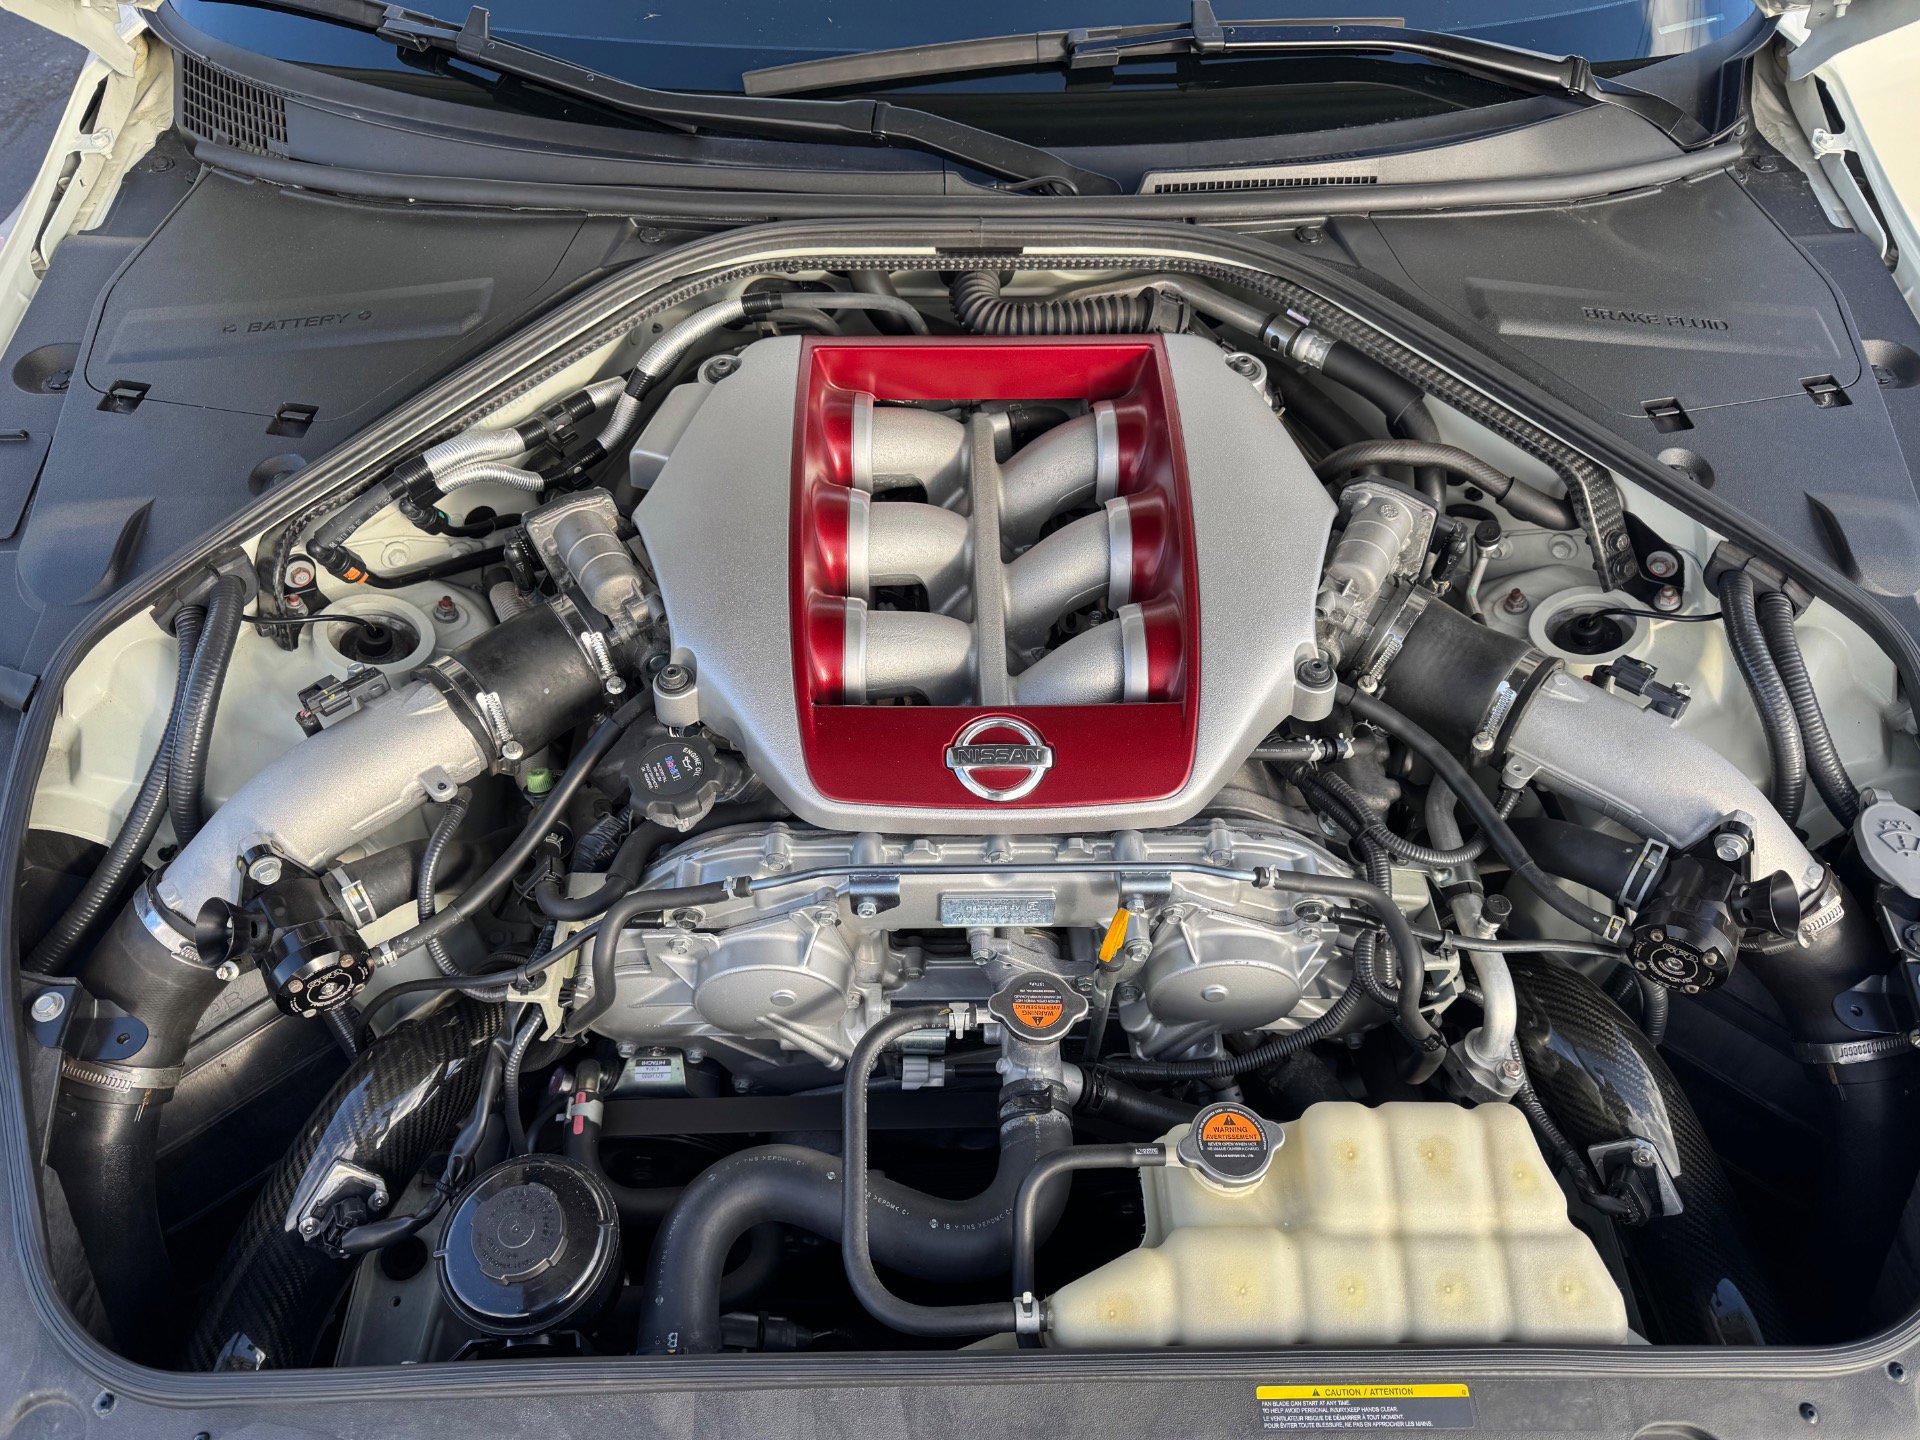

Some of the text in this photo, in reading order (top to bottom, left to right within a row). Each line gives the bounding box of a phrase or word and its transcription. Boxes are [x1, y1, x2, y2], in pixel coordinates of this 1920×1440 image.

[247, 313, 350, 333] BATTERY
[1582, 306, 1729, 331] BRAKE FLUID
[682, 747, 702, 777] ENGINE OIL
[957, 748, 1041, 763] NISSAN
[1324, 1388, 1361, 1396] CAUTION
[1369, 1387, 1414, 1395] ATTENTION
